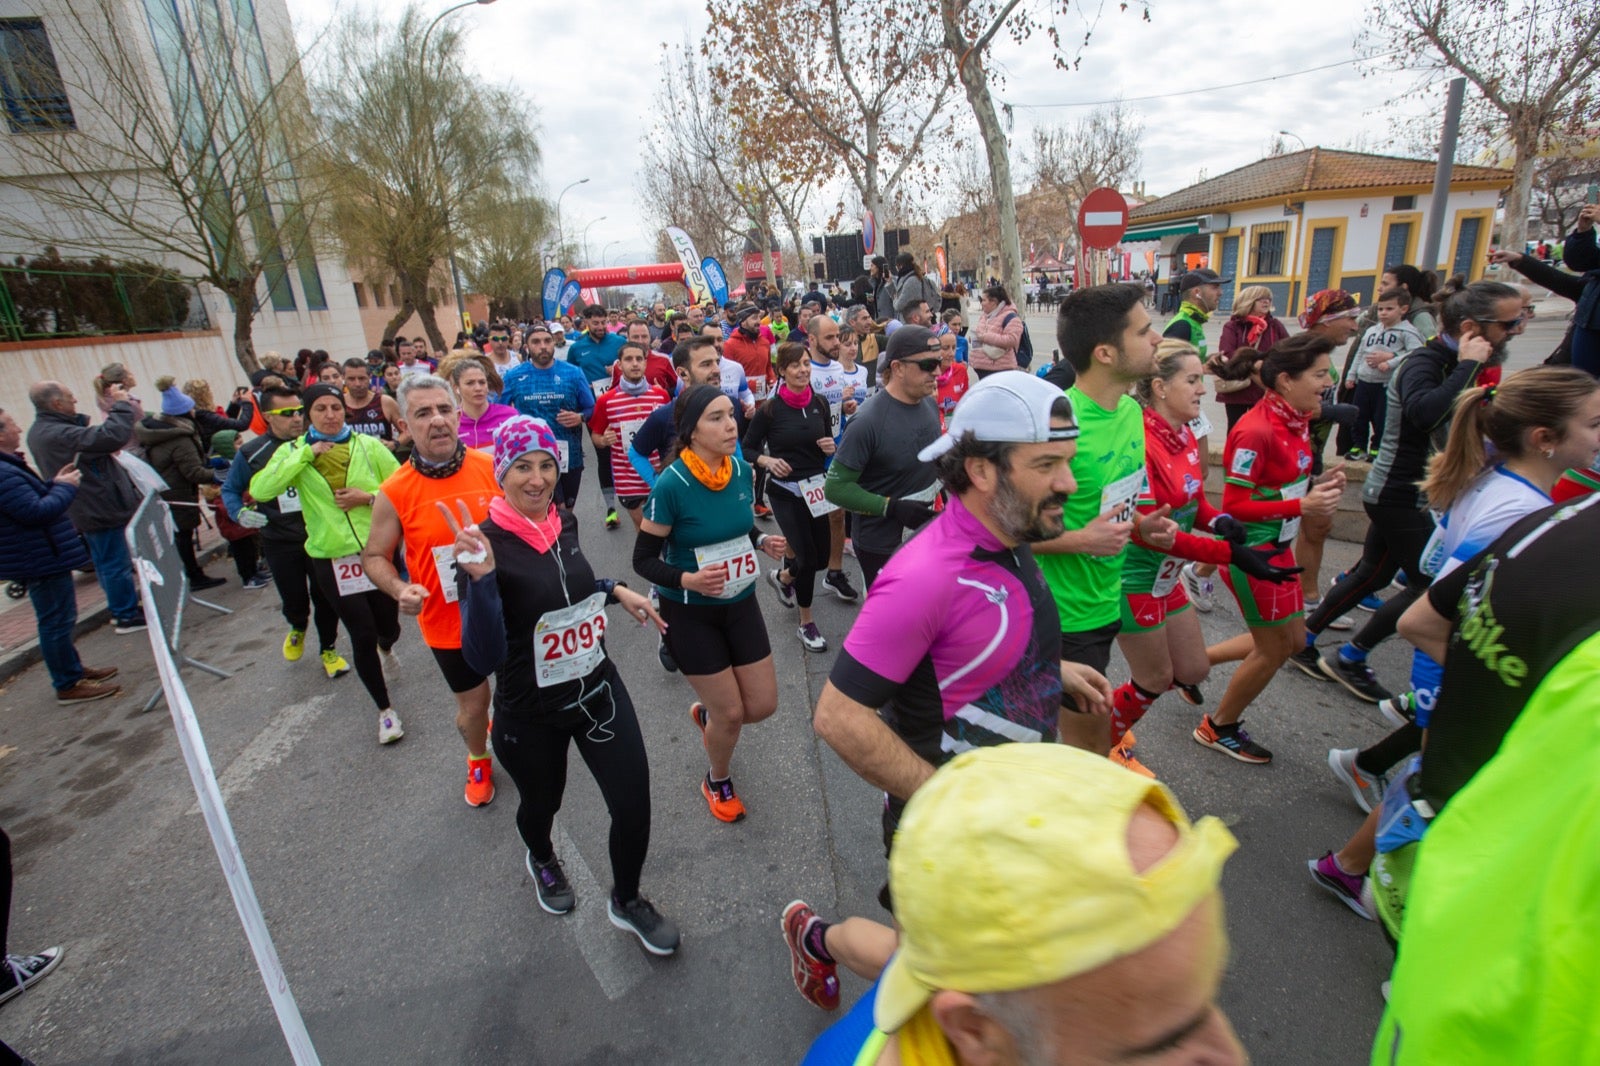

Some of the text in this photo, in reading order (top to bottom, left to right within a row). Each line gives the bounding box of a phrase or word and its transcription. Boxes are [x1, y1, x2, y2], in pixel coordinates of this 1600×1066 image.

[1366, 331, 1397, 347] GAP
[287, 485, 297, 498] 8
[806, 486, 825, 504] 20
[542, 615, 605, 662] 2093
